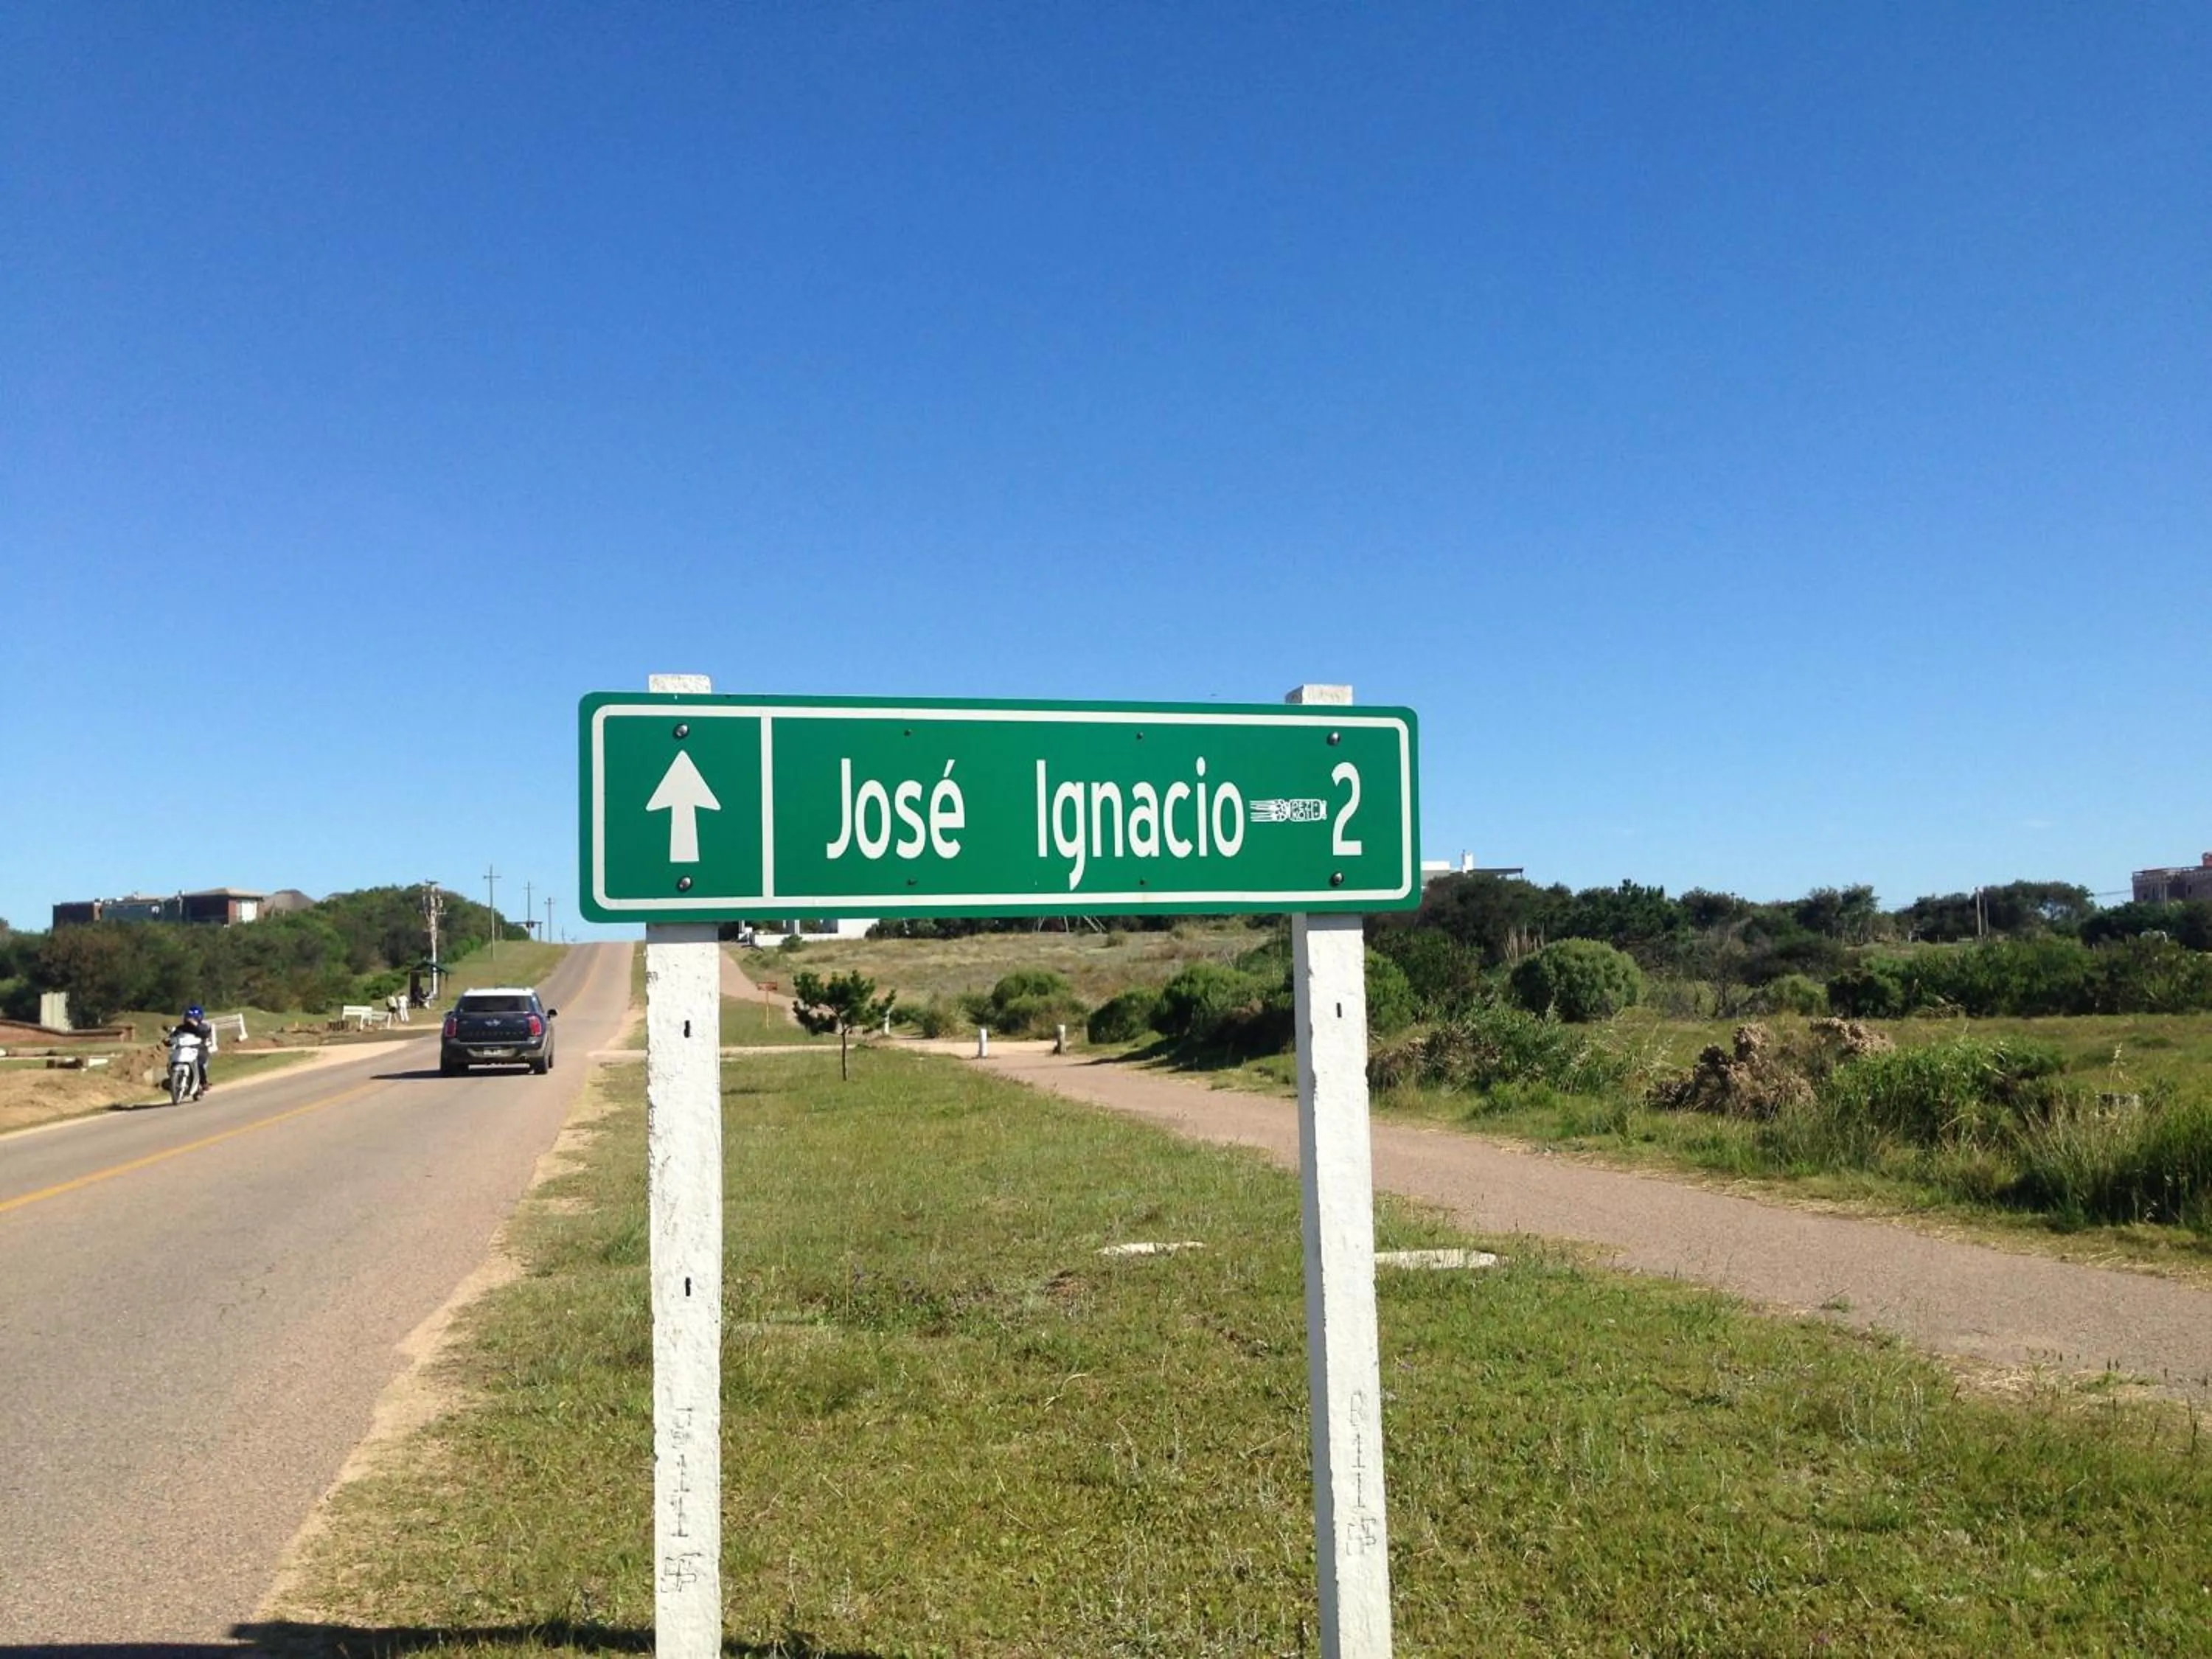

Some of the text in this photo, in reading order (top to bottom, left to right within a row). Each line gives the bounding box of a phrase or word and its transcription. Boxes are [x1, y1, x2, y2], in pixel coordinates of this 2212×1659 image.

[827, 757, 1362, 891] José Ignacio 2
